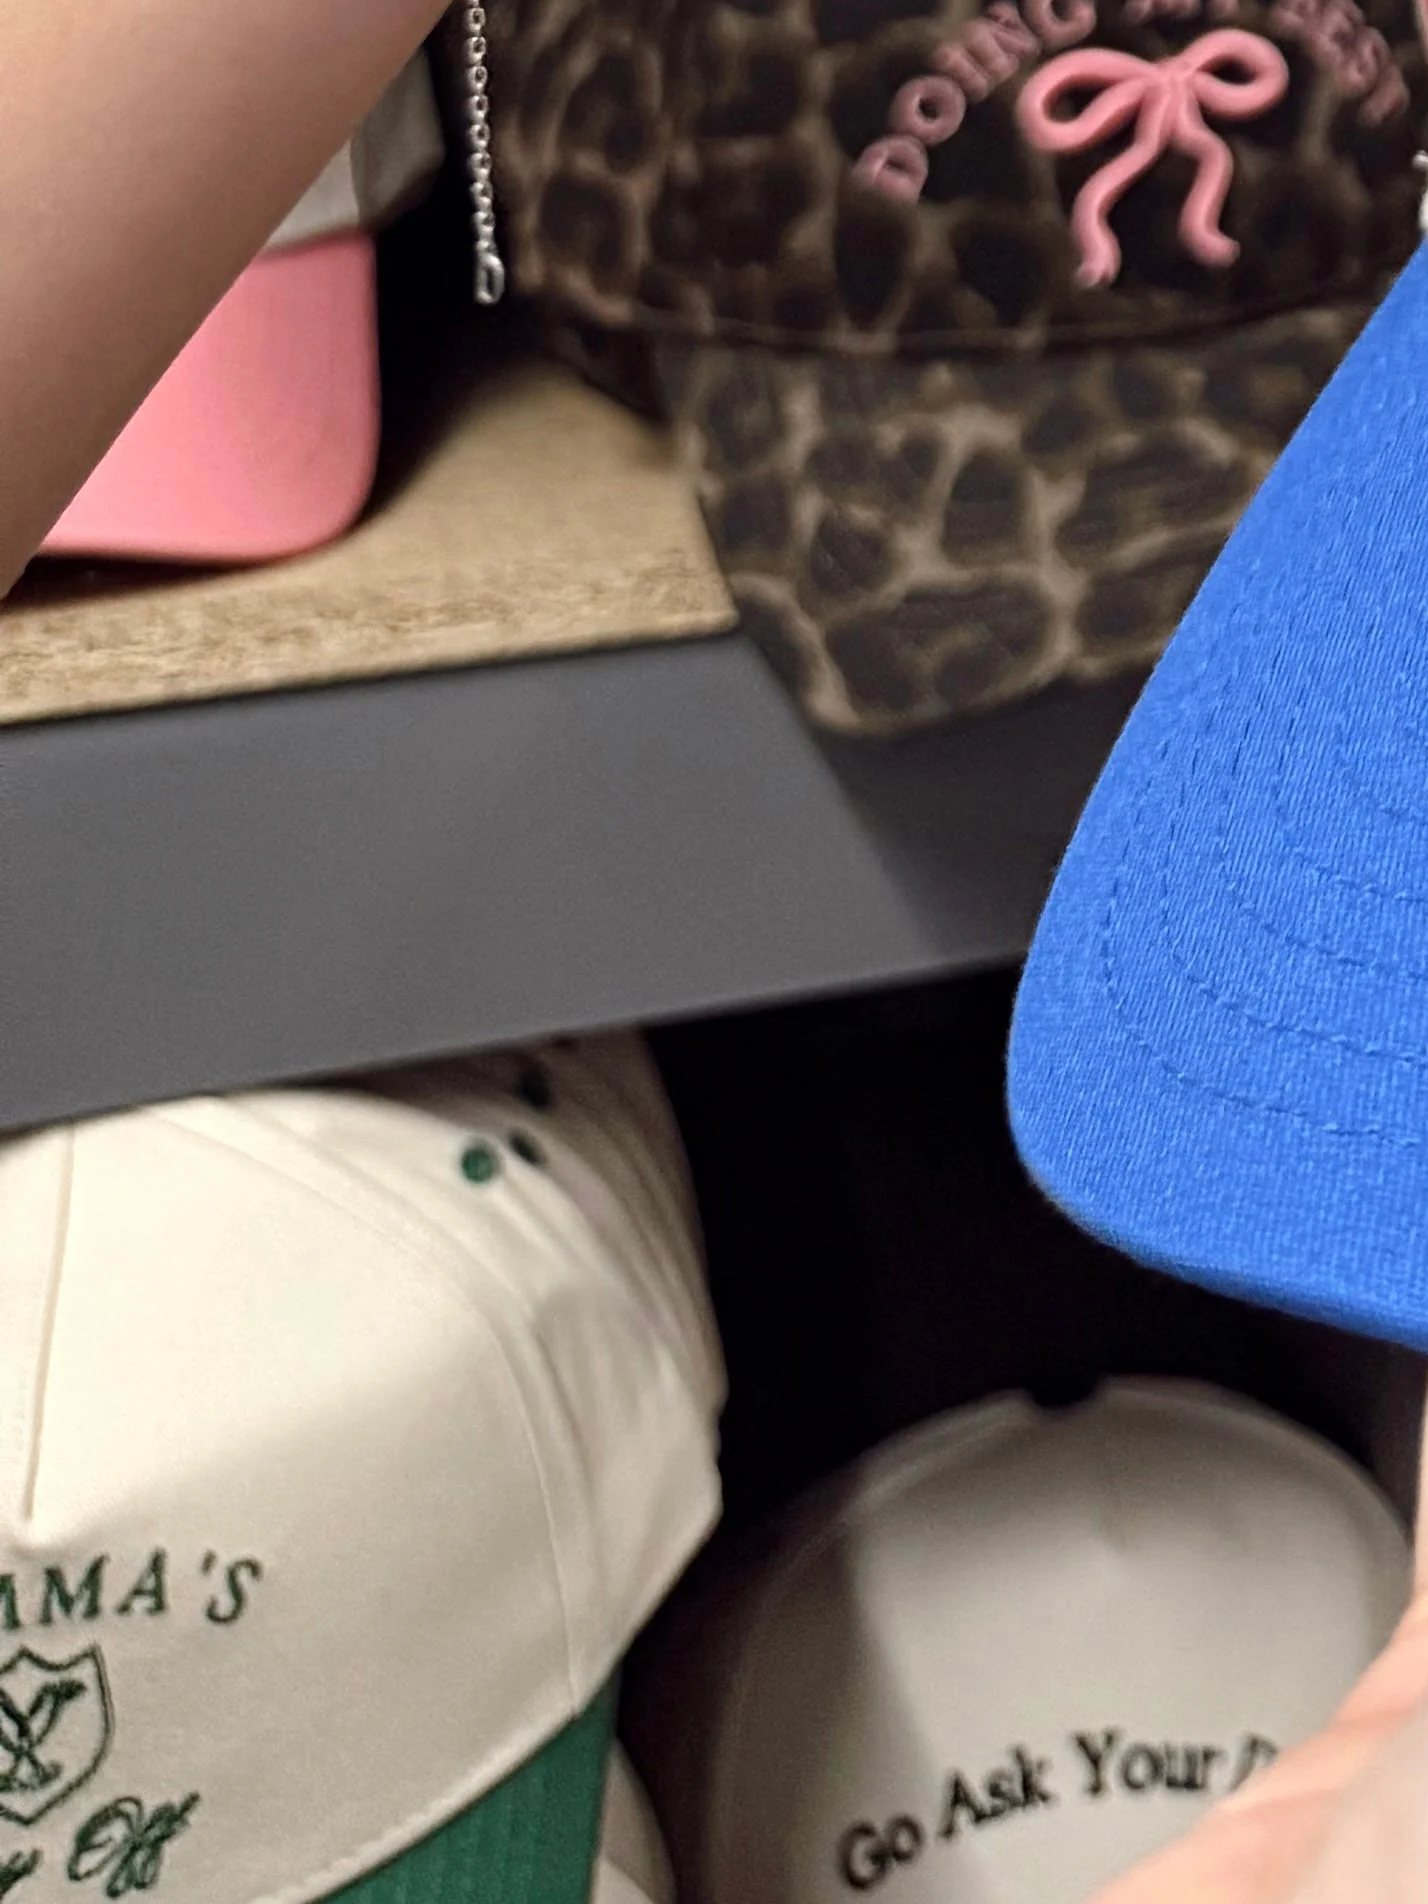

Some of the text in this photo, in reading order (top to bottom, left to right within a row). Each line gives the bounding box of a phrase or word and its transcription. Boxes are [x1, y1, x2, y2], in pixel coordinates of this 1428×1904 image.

[836, 1812, 927, 1892] Go
[938, 1742, 1056, 1840] Ask
[1071, 1726, 1222, 1796] Your
